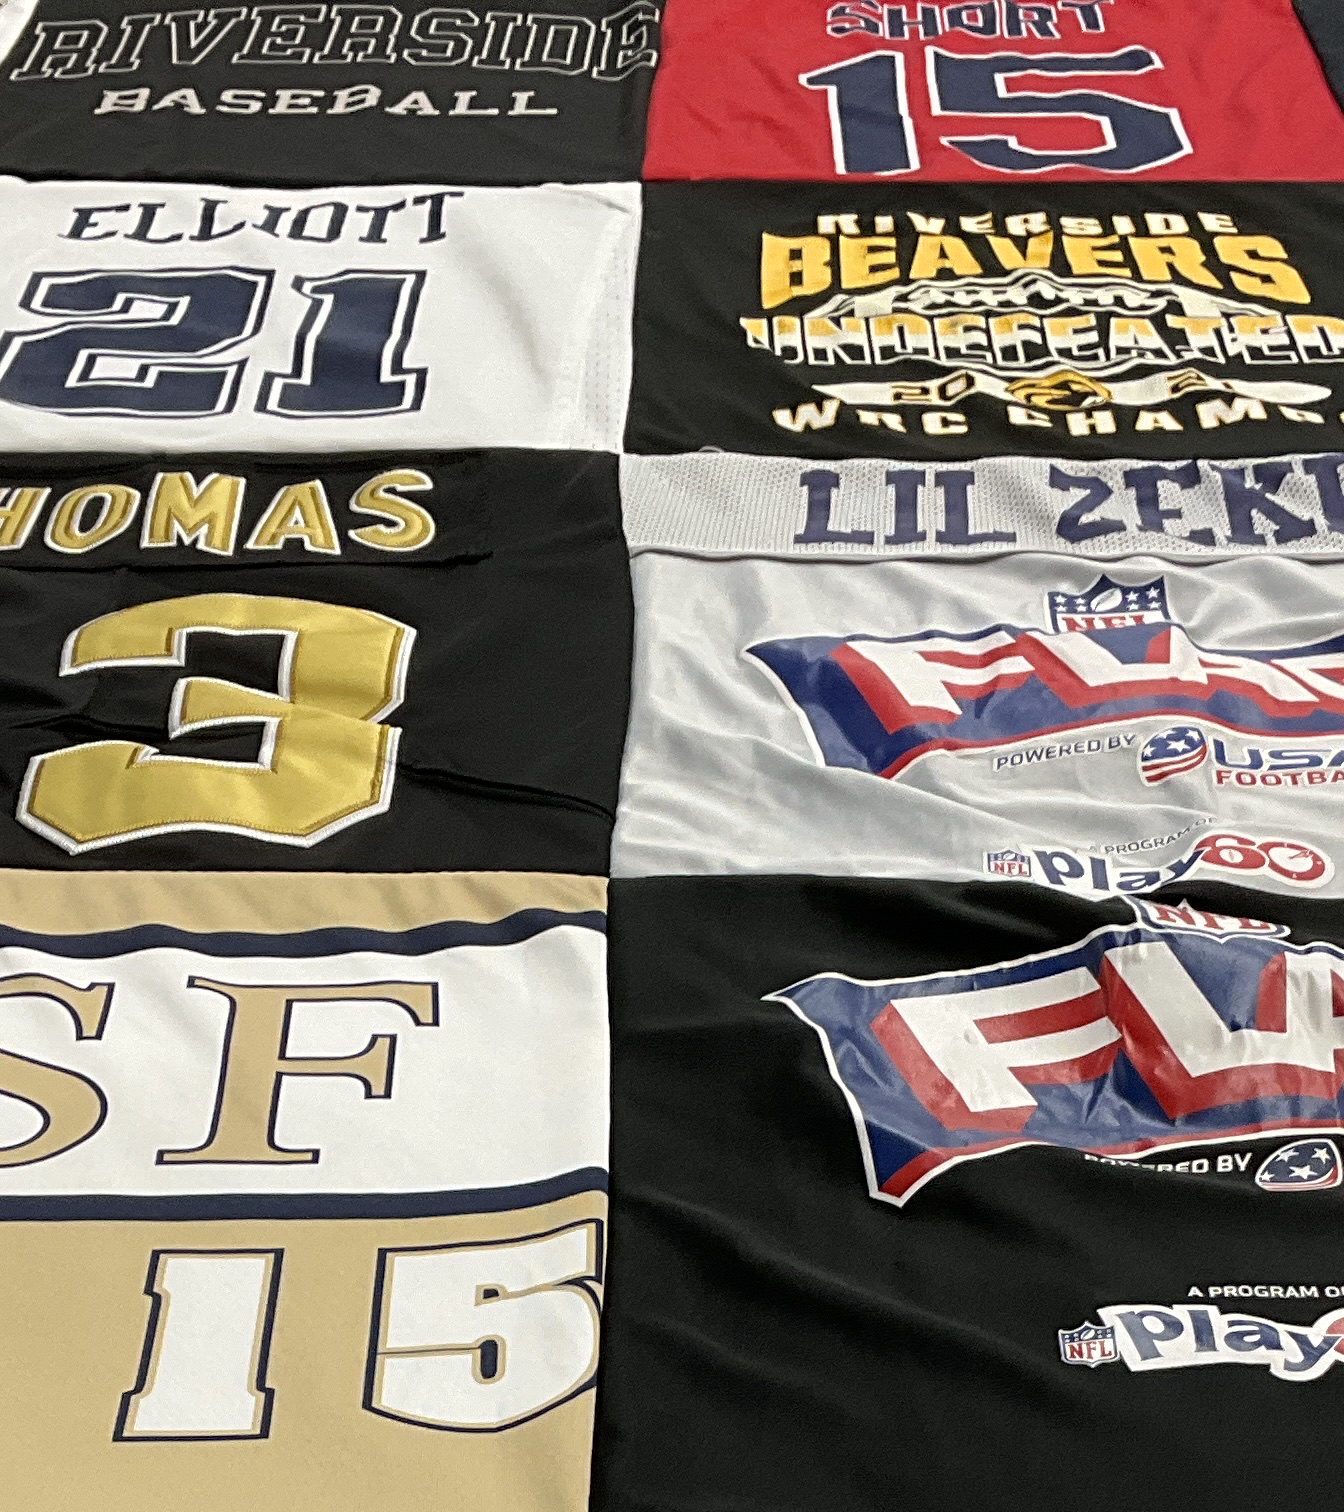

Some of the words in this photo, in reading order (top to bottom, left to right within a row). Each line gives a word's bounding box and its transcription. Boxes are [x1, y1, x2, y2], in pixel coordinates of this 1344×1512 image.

[826, 0, 1111, 40] SHORT
[10, 1, 660, 81] RIVERSIDE
[94, 84, 558, 116] BASEBALL
[798, 45, 1194, 176] 15
[58, 191, 464, 244] ELLIOTT
[816, 211, 1240, 236] RIVERSIDE
[760, 231, 1312, 309] BEAVERS
[793, 469, 1016, 546] LIL
[995, 738, 1102, 770] POWERED
[1107, 733, 1136, 751] BY
[1104, 828, 1193, 856] PROGRAM
[992, 861, 1029, 877] NFL
[1216, 1151, 1254, 1173] BY
[1186, 1286, 1204, 1298] A
[1207, 1285, 1319, 1299] PROGRAM
[112, 1217, 606, 1442] 15
[1066, 1341, 1113, 1361] NFL
